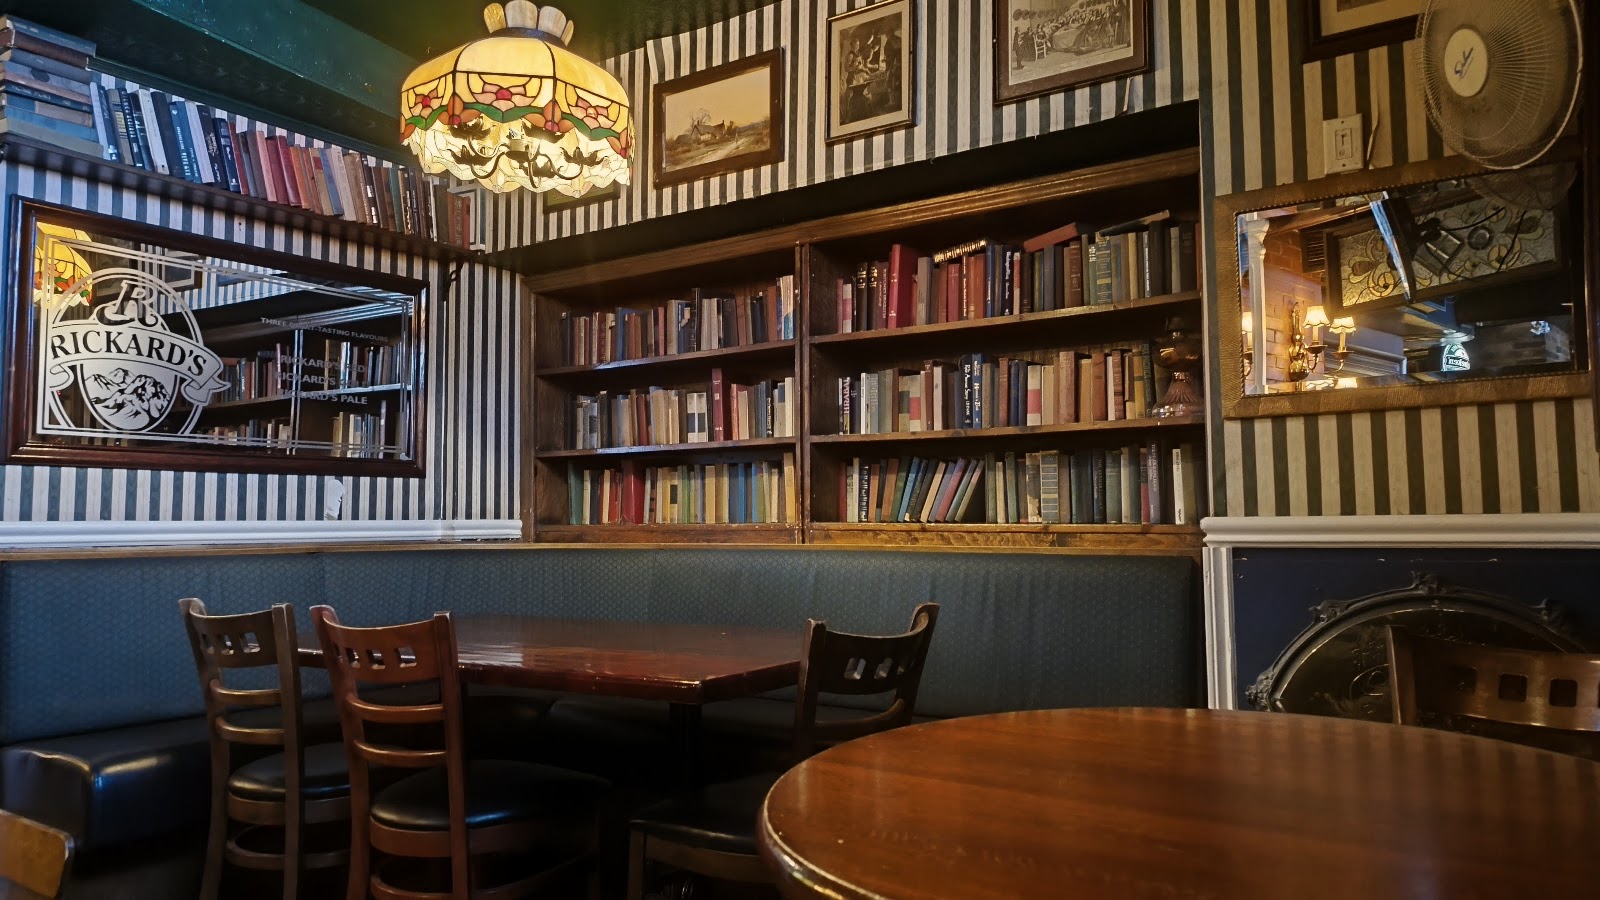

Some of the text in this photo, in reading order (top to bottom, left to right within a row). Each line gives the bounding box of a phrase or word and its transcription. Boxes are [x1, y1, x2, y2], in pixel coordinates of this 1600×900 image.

[260, 317, 287, 327] THREE
[351, 331, 389, 342] FLAVOURS
[51, 329, 208, 377] RICKARD'S
[280, 354, 340, 370] RICKARD'S
[275, 371, 336, 386] RICKARD'S
[340, 394, 368, 405] PALE
[843, 376, 851, 414] HRABAL
